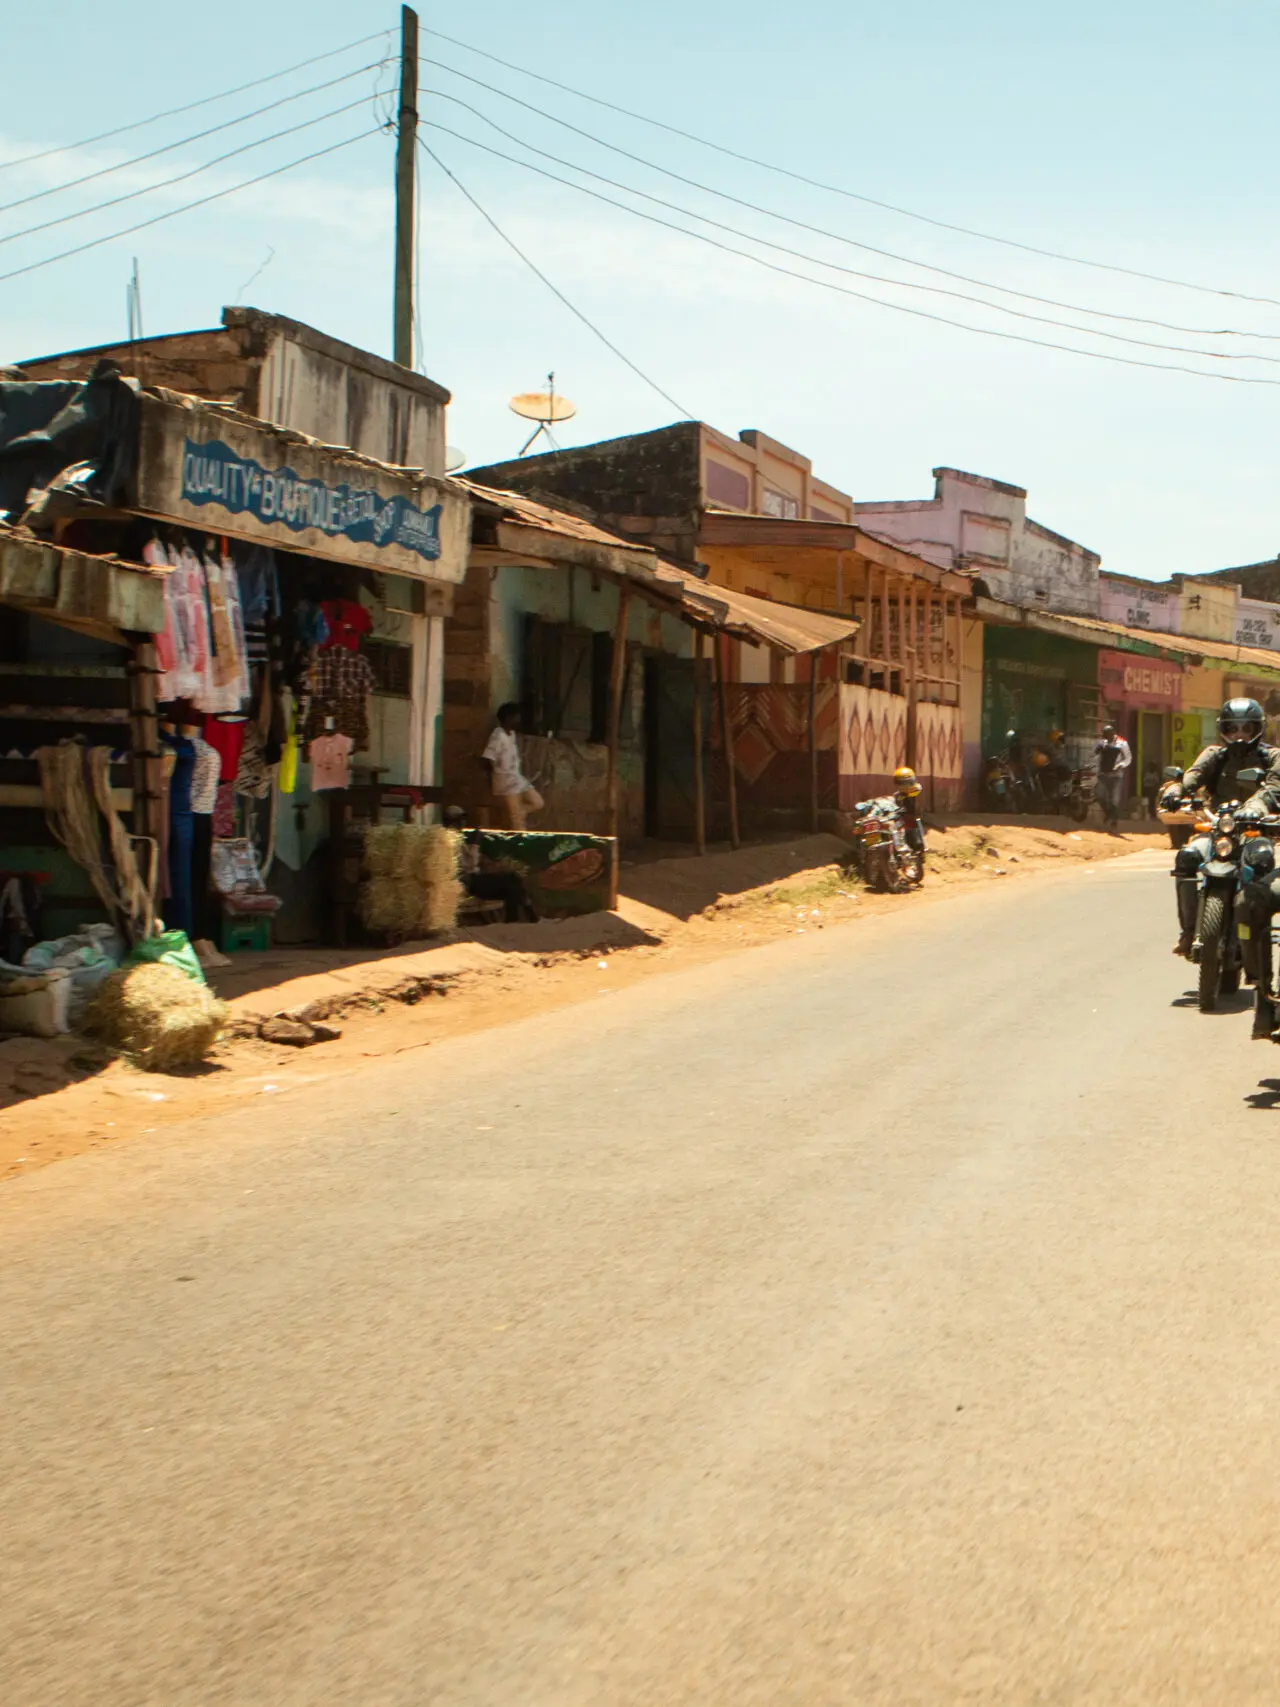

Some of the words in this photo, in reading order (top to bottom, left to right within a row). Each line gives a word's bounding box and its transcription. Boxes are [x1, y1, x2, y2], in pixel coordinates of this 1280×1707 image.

[184, 454, 255, 508] QUALITY
[261, 474, 344, 531] BOUTIQUE
[1126, 607, 1150, 625] CLINIC
[1123, 666, 1181, 697] CHEMIST
